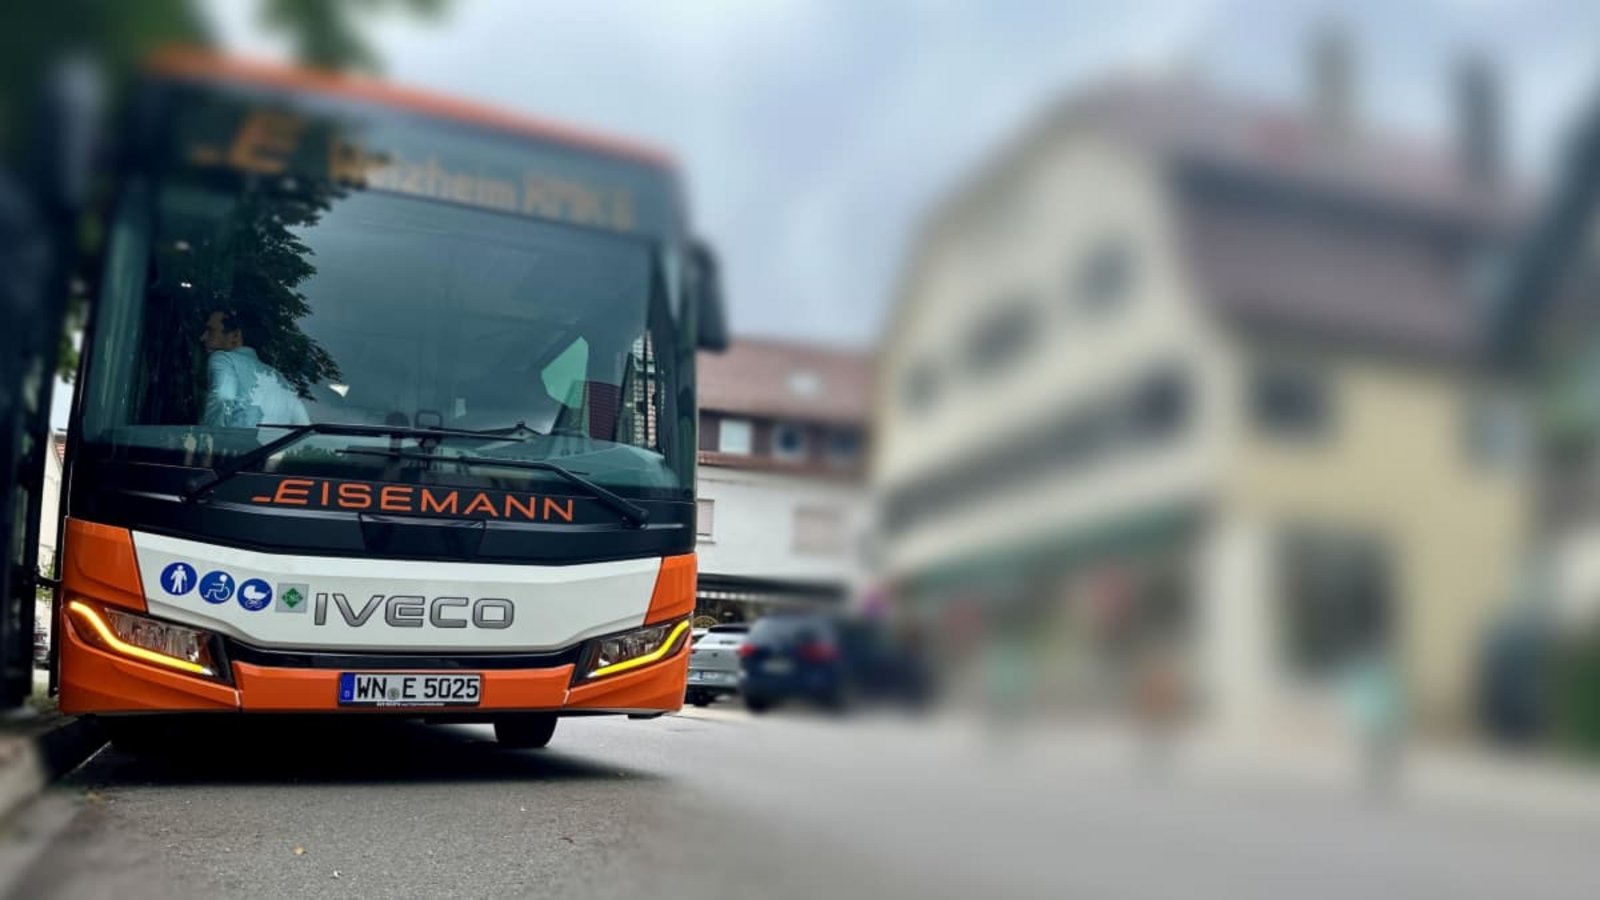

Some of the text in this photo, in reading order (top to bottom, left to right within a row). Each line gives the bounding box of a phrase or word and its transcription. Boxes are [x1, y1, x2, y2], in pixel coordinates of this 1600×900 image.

[273, 478, 574, 522] EISEMANN
[313, 592, 515, 629] IVECO
[357, 677, 479, 699] WN E 5025
